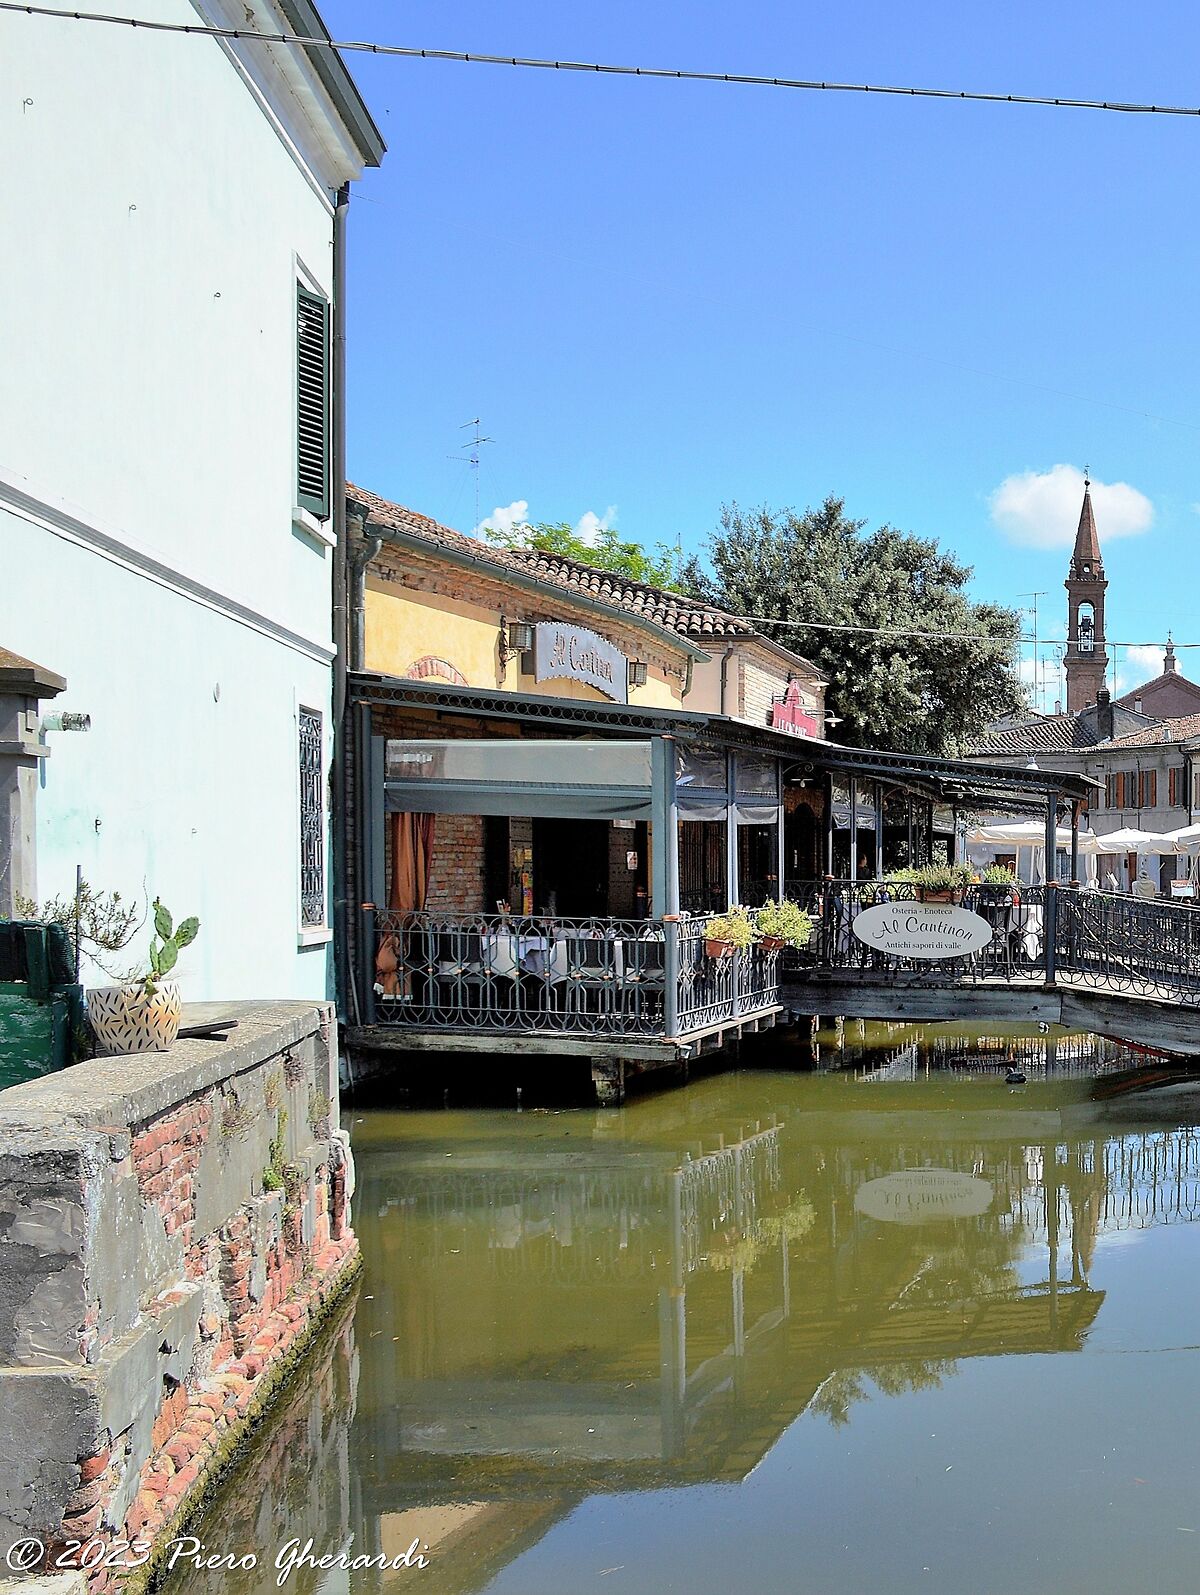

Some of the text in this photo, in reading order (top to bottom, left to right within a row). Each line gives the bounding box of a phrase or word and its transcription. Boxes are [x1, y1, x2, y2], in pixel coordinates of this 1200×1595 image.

[891, 907, 918, 915] Osteria
[924, 907, 953, 915] Enoteca
[872, 919, 899, 939] Al
[885, 941, 962, 950] Antichi sapori di valle
